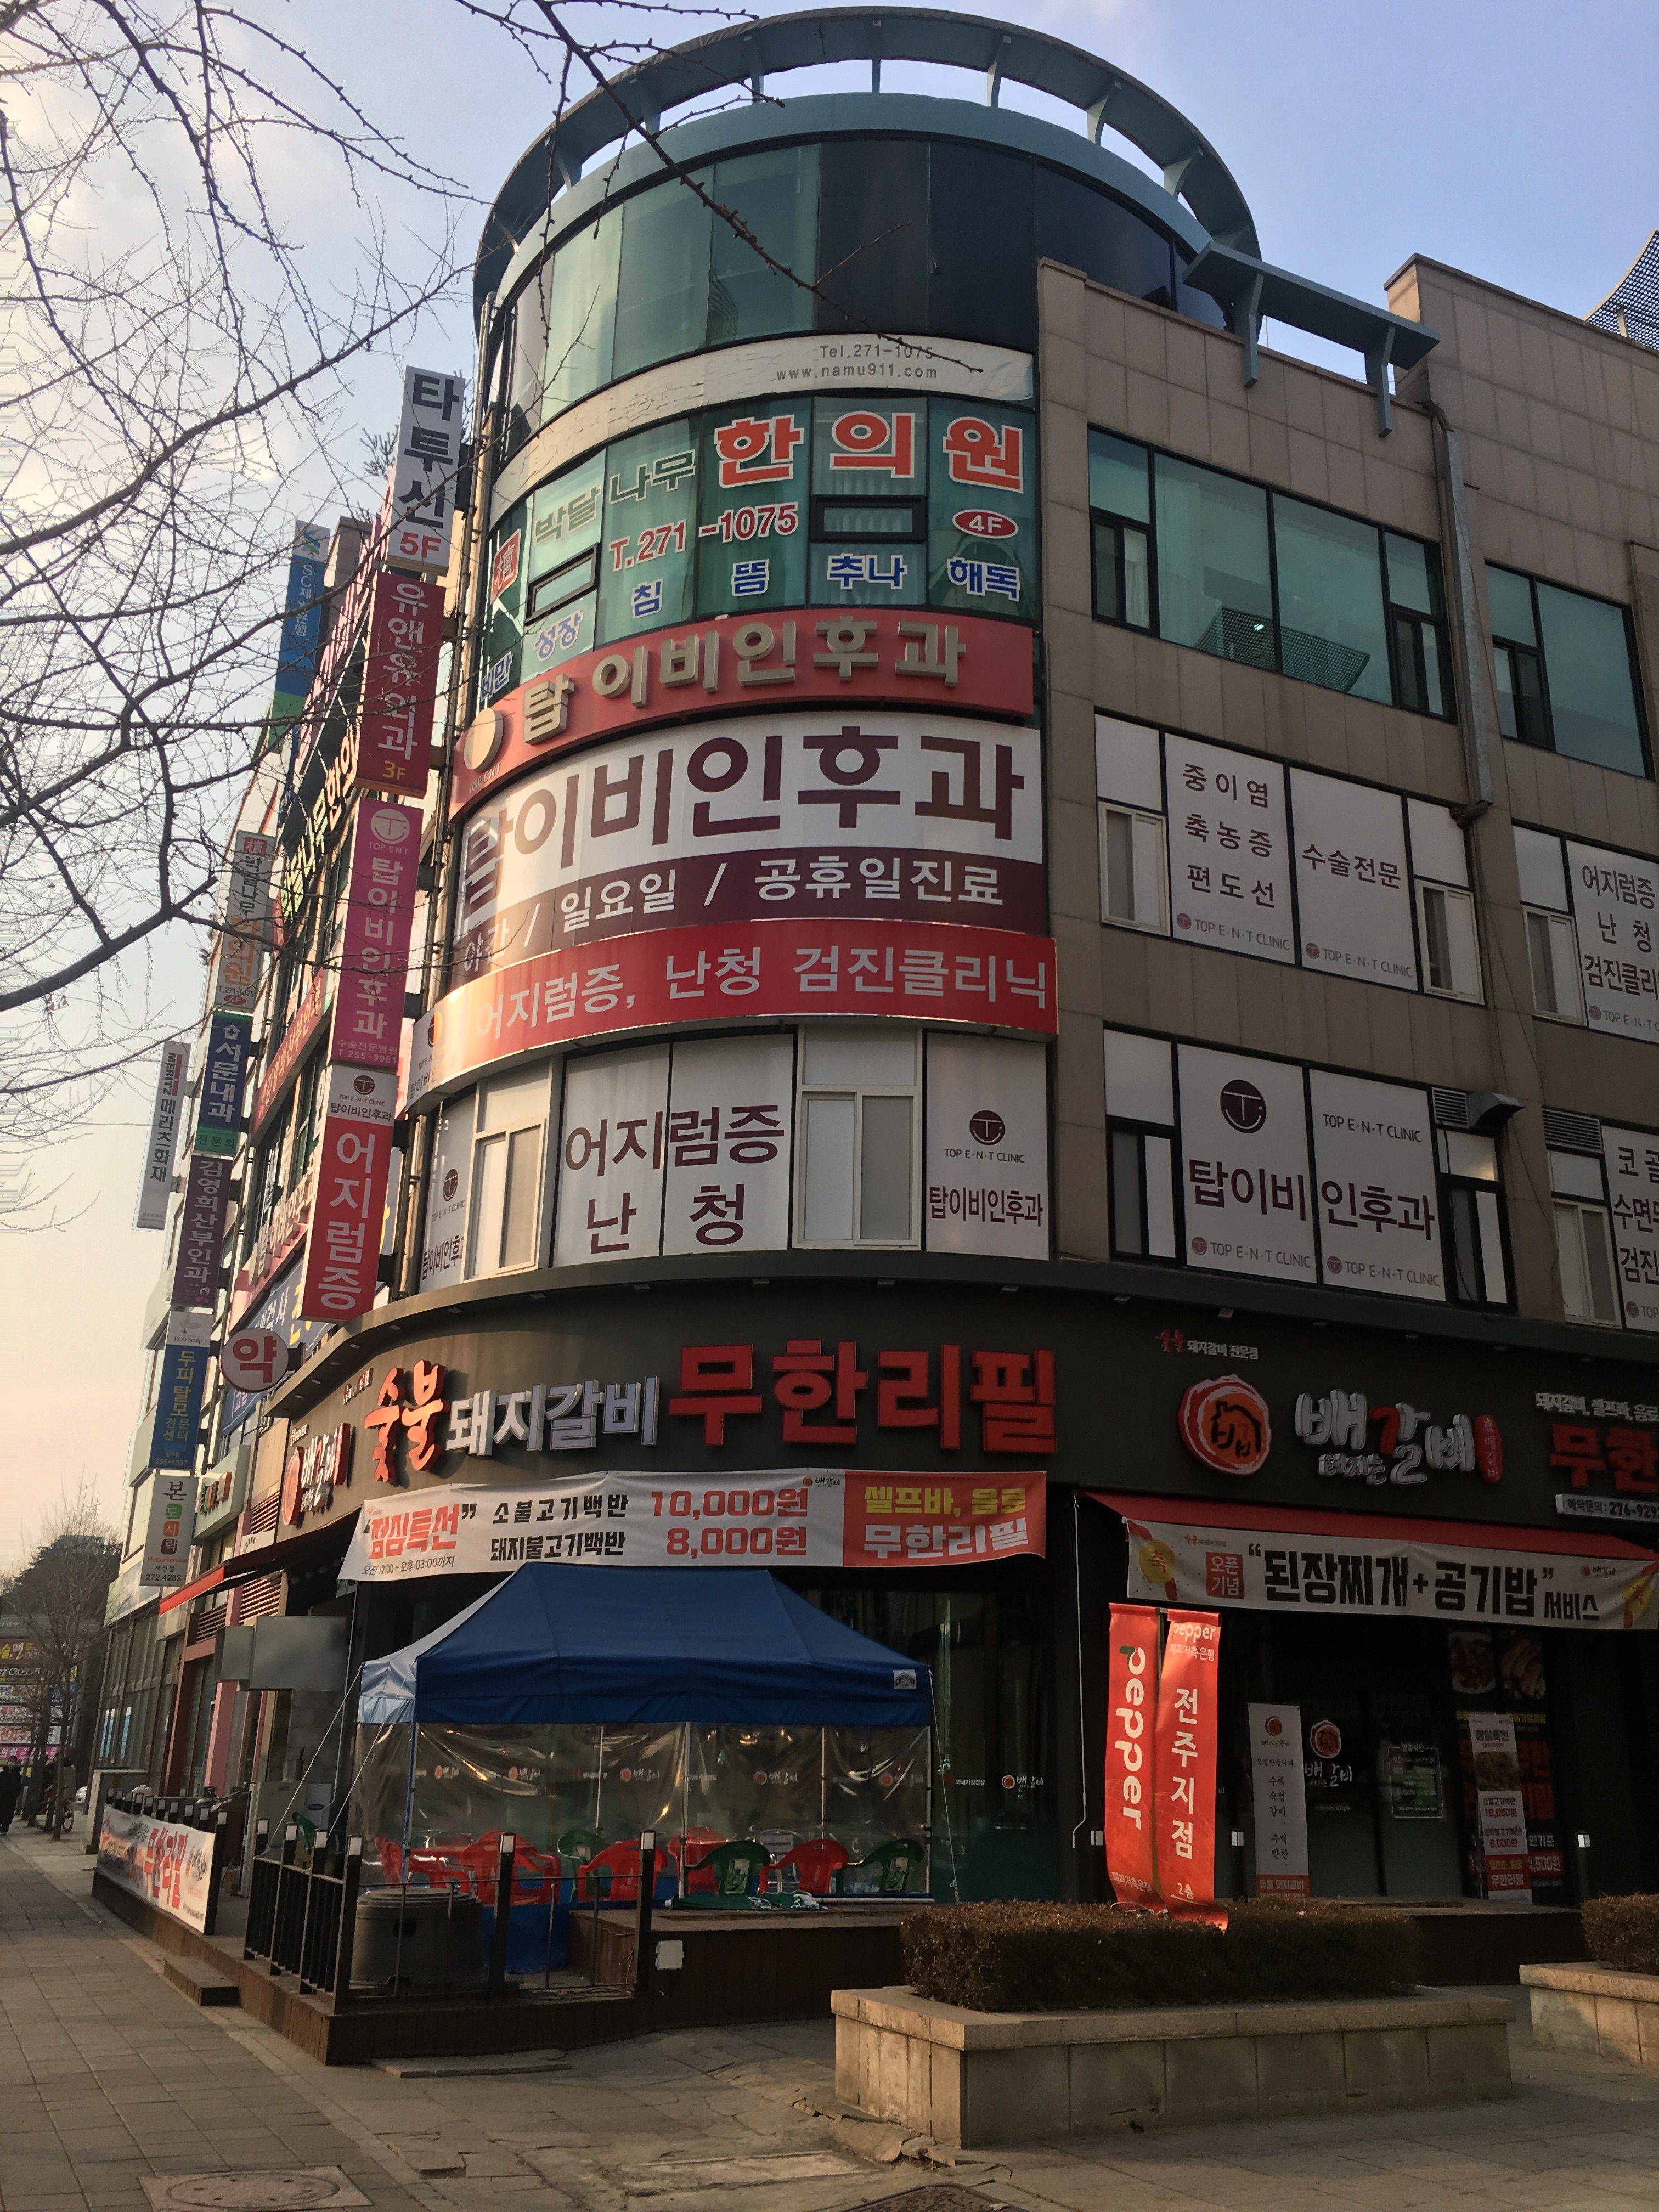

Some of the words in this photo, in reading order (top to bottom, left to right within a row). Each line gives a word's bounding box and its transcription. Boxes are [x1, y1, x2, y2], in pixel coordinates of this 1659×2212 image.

[820, 345, 934, 360] Tel.271-1075
[776, 363, 938, 381] www.namu911.com
[398, 374, 460, 529] 타투신
[534, 447, 697, 546] 박달나무
[714, 410, 1024, 494] 한의원
[966, 515, 1004, 535] 4F
[399, 532, 442, 558] 5F
[631, 578, 663, 619] 침
[731, 558, 770, 598] 뜸
[826, 552, 909, 590] 추나
[947, 557, 1021, 603] 해독
[534, 609, 584, 662] 성장
[479, 651, 514, 703] 비만
[522, 614, 967, 745] 탑이비인후과
[383, 760, 406, 781] 3F
[1182, 763, 1269, 809] 중이염
[464, 726, 1025, 922] 탑이비인후과
[1184, 813, 1273, 858] 축농증
[368, 840, 388, 853] TOP
[1302, 844, 1401, 890] 수술전문
[560, 868, 677, 935] 일요일
[754, 855, 1005, 907] 공휴일진료
[1187, 864, 1275, 909] 편도선
[1582, 865, 1655, 910] 어지럼증
[352, 856, 403, 1039] 탑이비인후과
[1194, 918, 1215, 933] TOP
[1256, 933, 1290, 951] CLINIC
[1597, 911, 1652, 953] 난청
[666, 947, 761, 1001] 난청
[793, 944, 1047, 1009] 검진클리닉
[1322, 947, 1342, 962] TOP
[1380, 960, 1413, 978] CLINIC
[1584, 955, 1659, 1001] 검진클리
[1603, 1009, 1621, 1023] TOP
[338, 1048, 397, 1064] T.255-9981
[207, 1042, 241, 1123] 서문내과
[330, 1102, 392, 1122] 탑이비인후과
[1323, 1114, 1344, 1129] TOP
[1387, 1125, 1422, 1143] CLINIC
[150, 1098, 177, 1183] 메리츠화재
[198, 1134, 235, 1149] 전문의
[565, 1104, 785, 1178] 어지럼증
[944, 1148, 962, 1159] TOP
[996, 1152, 1025, 1165] CLINIC
[184, 1160, 223, 1283] 김영희산부인과
[317, 1131, 377, 1312] 어지럼증
[586, 1182, 746, 1255] 난청
[929, 1187, 1043, 1227] 탑이비인후과
[1210, 1242, 1232, 1256] TOP
[1276, 1251, 1311, 1269] CLINIC
[1344, 1260, 1365, 1275] TOP
[1406, 1270, 1440, 1288] CLINIC
[232, 1336, 278, 1384] 약
[1187, 1340, 1227, 1357] 돼지갈비
[1228, 1344, 1259, 1361] 전문점
[363, 1359, 449, 1483] 숯불
[446, 1375, 658, 1456] 돼지갈비
[668, 1339, 1057, 1454] 무한리필
[492, 1494, 629, 1525] 소불고기백반
[651, 1487, 809, 1520] 10,000원
[864, 1486, 961, 1517] 셀프바,
[972, 1487, 1026, 1515] 음료
[1609, 1501, 1659, 1519] 276-929
[490, 1531, 627, 1562] 돼지불고기백반
[666, 1526, 808, 1559] 8,000원
[864, 1517, 1029, 1559] 무한리필
[361, 1565, 377, 1576] 오전
[400, 1559, 414, 1572] 오후
[415, 1555, 455, 1570] 03:00까지
[1148, 1549, 1167, 1574] 축
[1211, 1555, 1239, 1576] 오픈
[1211, 1576, 1240, 1597] 기념
[1544, 1592, 1600, 1621] 서비스
[1172, 1621, 1216, 1641] pepper
[1169, 1642, 1215, 1662] 페퍼저축은행
[1114, 1646, 1146, 1831] pepper
[1171, 1688, 1198, 1859] 전주지점
[1268, 1776, 1285, 1788] 수제
[1268, 1790, 1285, 1803] 숙성
[1271, 1832, 1287, 1845] 수제
[1272, 1848, 1289, 1860] 반찬
[1111, 1871, 1153, 1895] 페퍼저축은행
[1177, 1882, 1194, 1900] 2층
